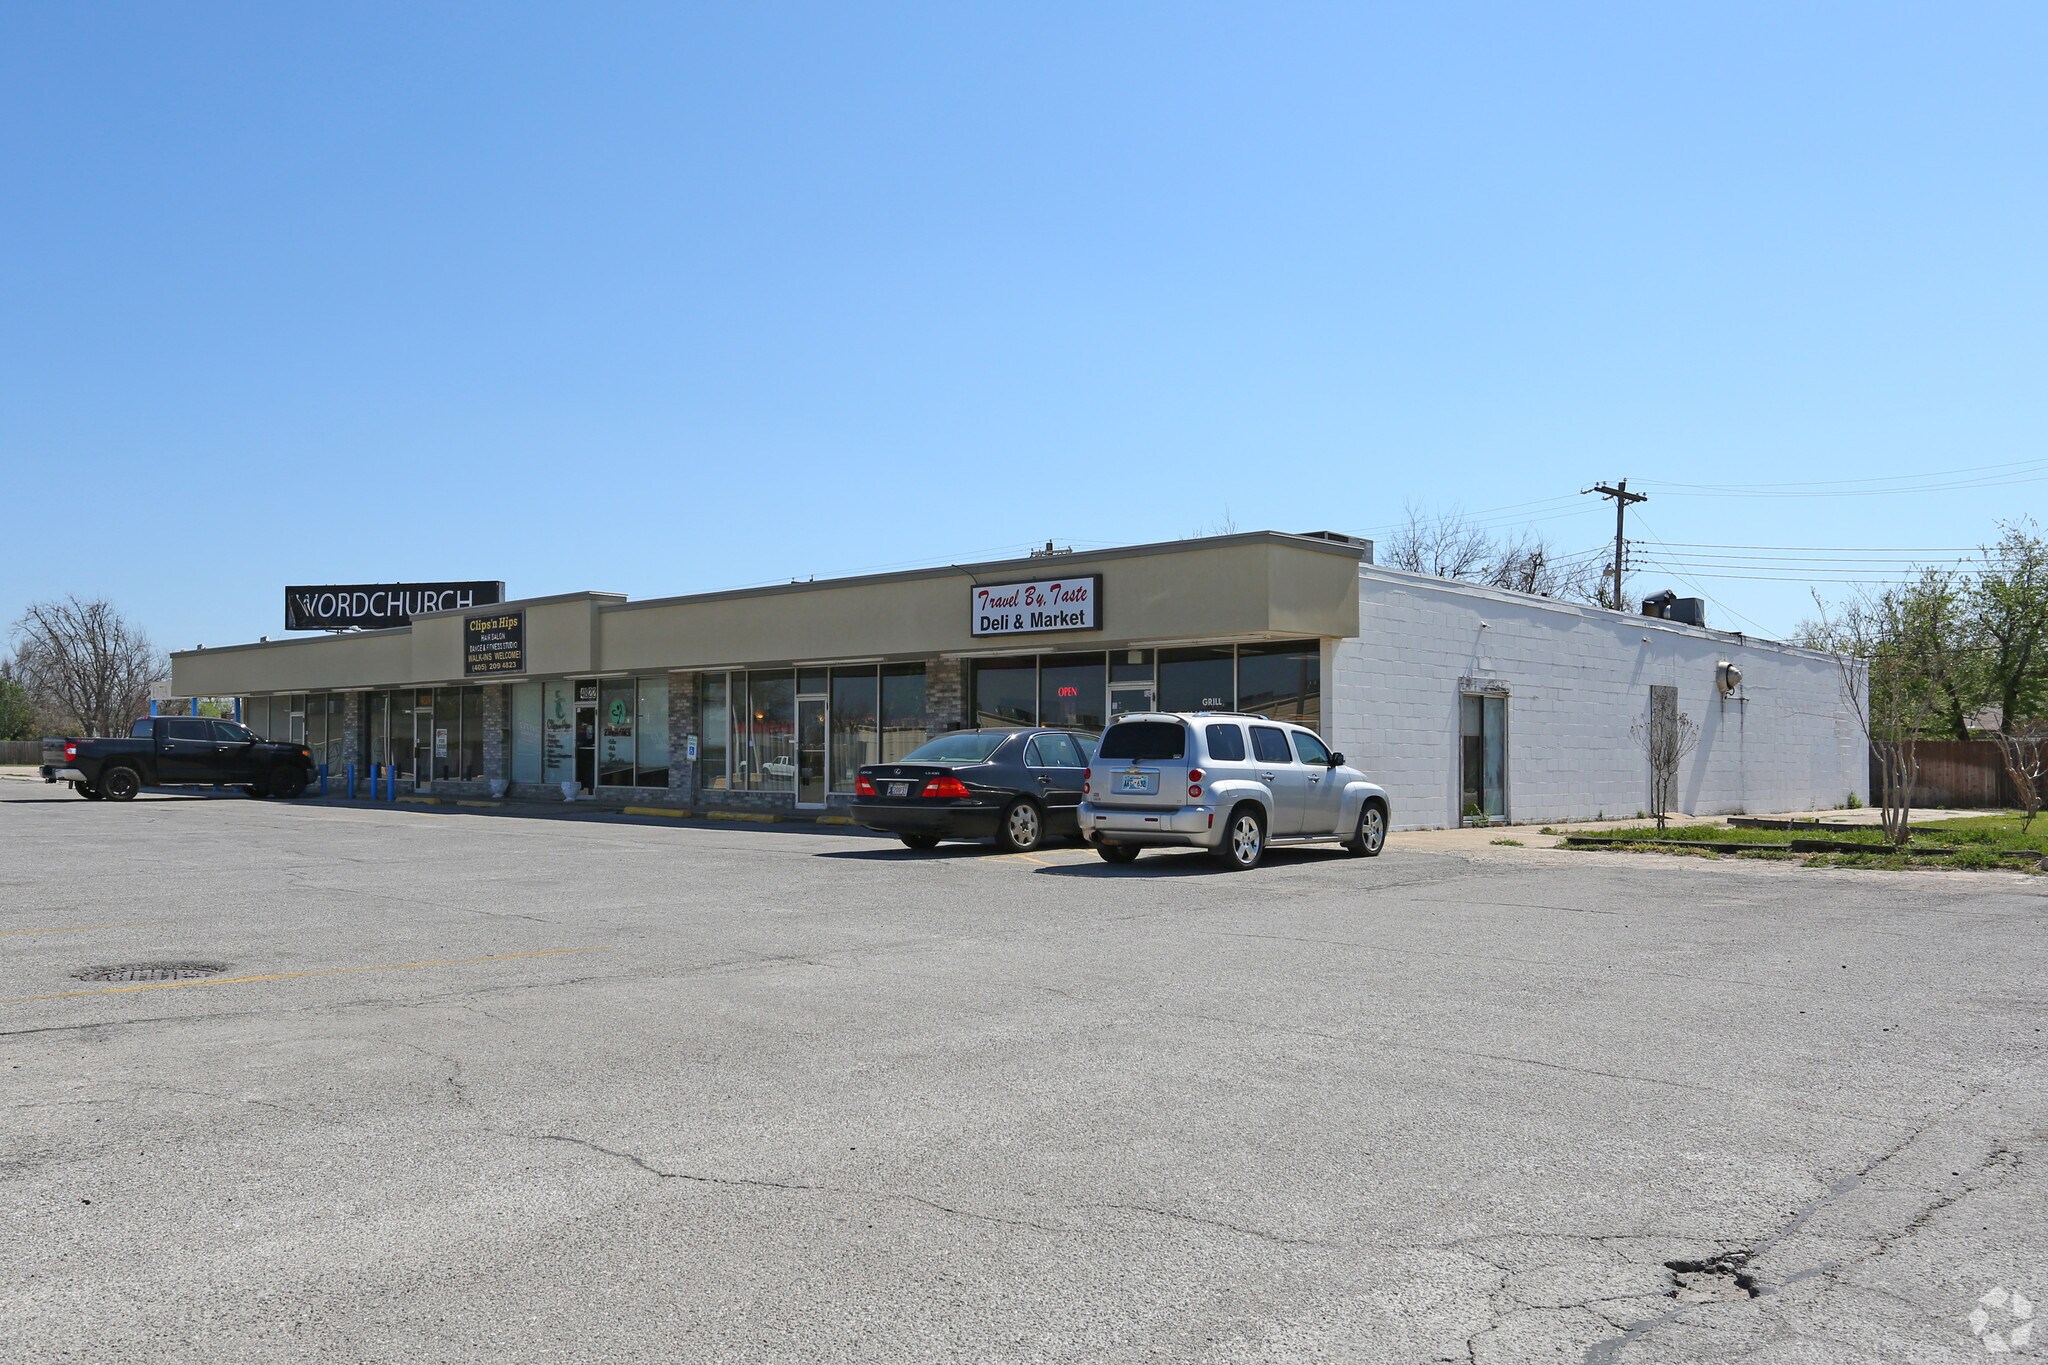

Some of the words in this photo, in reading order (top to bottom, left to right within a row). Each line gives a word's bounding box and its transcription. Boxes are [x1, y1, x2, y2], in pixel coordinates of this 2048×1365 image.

[296, 589, 474, 617] WORDCHURCH
[978, 589, 1019, 611] Travel
[1050, 583, 1087, 606] Taste
[499, 617, 518, 629] Hips
[980, 615, 1009, 631] Deli
[1013, 613, 1024, 630] &
[1030, 609, 1085, 628] Market
[471, 663, 487, 672] (405)
[489, 662, 501, 670] 209
[1057, 687, 1078, 697] OPEN
